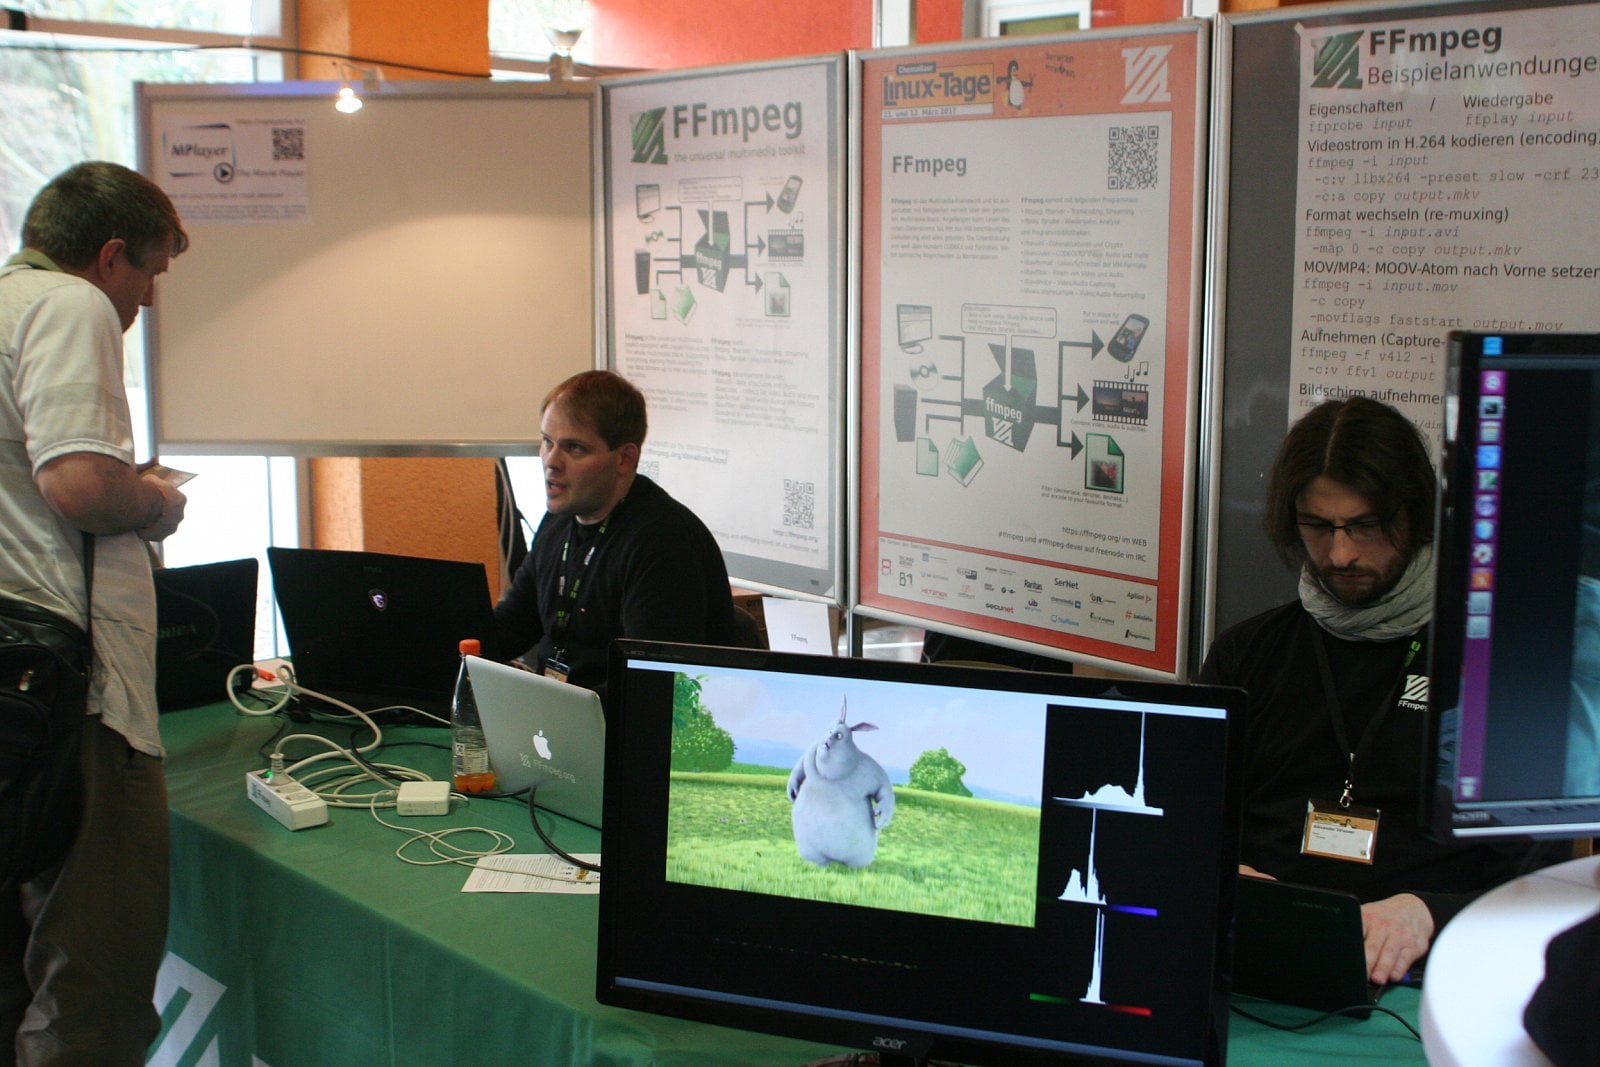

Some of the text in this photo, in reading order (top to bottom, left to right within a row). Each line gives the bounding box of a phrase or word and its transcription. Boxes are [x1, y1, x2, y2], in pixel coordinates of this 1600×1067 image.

[1369, 25, 1503, 57] FFmpeg
[1367, 55, 1600, 85] Beispielanwendunge
[884, 72, 991, 106] Linux-Tage
[1309, 100, 1403, 116] Eigenschaften
[1463, 92, 1553, 109] Wiedergabe
[673, 101, 802, 142] FFmpeg
[1309, 110, 1573, 133] ffprobe input ffplay input
[1308, 129, 1600, 152] Videostrom in H.264 kodieren (encoding
[892, 155, 967, 176] FFmpeg
[1308, 154, 1428, 170] ffmpeg -i input
[1315, 167, 1599, 186] -c:v libx264 -preset slow -crf 23
[1354, 191, 1385, 204] copy
[1394, 188, 1480, 203] output.mkv
[1305, 207, 1509, 223] Format wechseln (re-muxing)
[1305, 226, 1460, 240] ffmpeg -i input.avi
[1313, 244, 1343, 257] -map
[1368, 244, 1383, 255] -c
[1392, 245, 1425, 258] copy
[1433, 245, 1521, 258] output.mkv
[1304, 262, 1370, 275] MOV/MP4:
[1375, 262, 1458, 276] MOOV-Atom
[1464, 263, 1498, 277] nach
[1503, 264, 1546, 278] Vorne
[1304, 278, 1458, 294] ffmpeg -i input.mov
[1310, 296, 1365, 310] -c copy
[1310, 311, 1563, 331] -movflags faststart output.mov
[1301, 330, 1446, 349] Aufnehmen (Capture-
[1300, 347, 1346, 361] ffmpeg
[1355, 349, 1370, 361] -f
[1420, 352, 1435, 364] -i
[1386, 368, 1435, 382] output
[1299, 384, 1366, 399] Bildschirm
[986, 396, 1022, 424] ffmpeg
[1024, 534, 1037, 544] und
[1084, 543, 1095, 553] auf
[1096, 545, 1125, 559] freenode
[1125, 551, 1135, 560] im
[1136, 553, 1147, 562] IRC
[1122, 536, 1131, 544] im
[1132, 537, 1148, 547] WEB
[899, 571, 913, 587] B1
[1054, 577, 1079, 590] SerNet
[872, 1036, 908, 1050] acer
